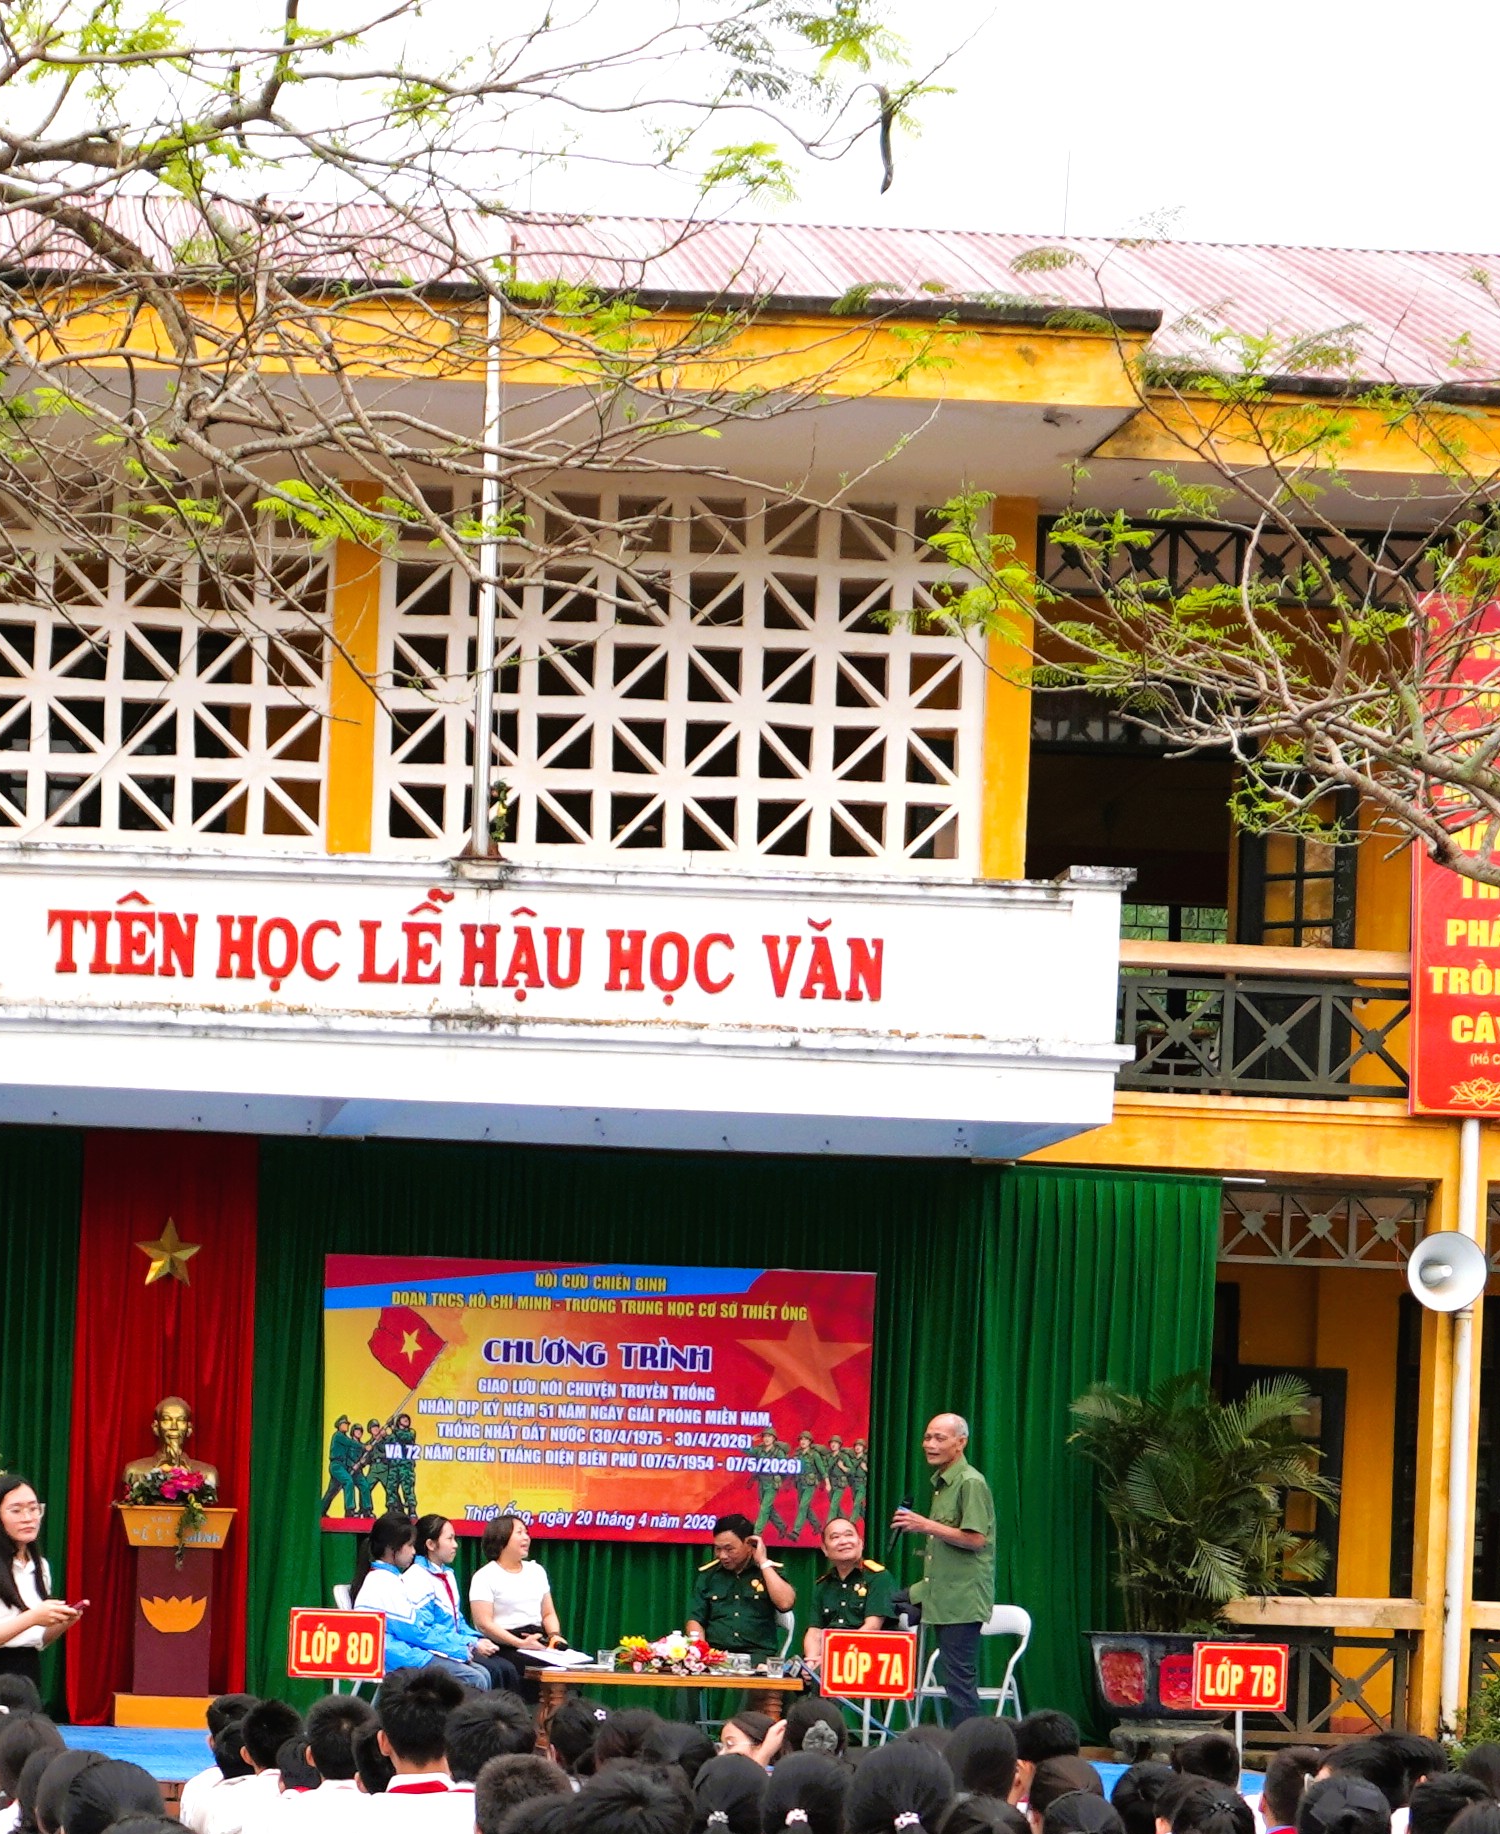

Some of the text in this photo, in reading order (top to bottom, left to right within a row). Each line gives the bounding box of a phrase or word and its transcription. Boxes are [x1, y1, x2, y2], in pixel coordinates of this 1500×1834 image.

[216, 914, 342, 993] HỌC
[359, 887, 455, 985] LỄ
[459, 905, 584, 1002] HẬU
[605, 929, 735, 1006] HỌC
[762, 916, 883, 1003] VĂN
[635, 1277, 666, 1292] BINH
[431, 1292, 464, 1308] TNCS
[518, 1295, 551, 1311] MINH
[620, 1299, 663, 1316] TRUNG
[667, 1301, 694, 1319] HỌC
[482, 1336, 713, 1372] CHƯƠNG TRÌNH
[478, 1378, 508, 1394] GIAO
[539, 1403, 554, 1418] 51
[740, 1411, 772, 1428] NAM,
[589, 1428, 662, 1446] (30/4/1975
[674, 1432, 752, 1449] 30/4/2026)
[405, 1444, 420, 1460] 72
[641, 1453, 714, 1471] (07/5/1954
[726, 1457, 801, 1474] 07/5/2026)
[539, 1508, 572, 1528] ngày
[576, 1509, 592, 1526] 20
[596, 1511, 634, 1531] tháng
[638, 1511, 645, 1527] 4
[650, 1512, 680, 1529] năm
[683, 1514, 717, 1531] 2026
[299, 1622, 373, 1663] LỚP 8D
[831, 1642, 903, 1686] LỚP 7A
[1204, 1657, 1276, 1699] LỚP 7B
